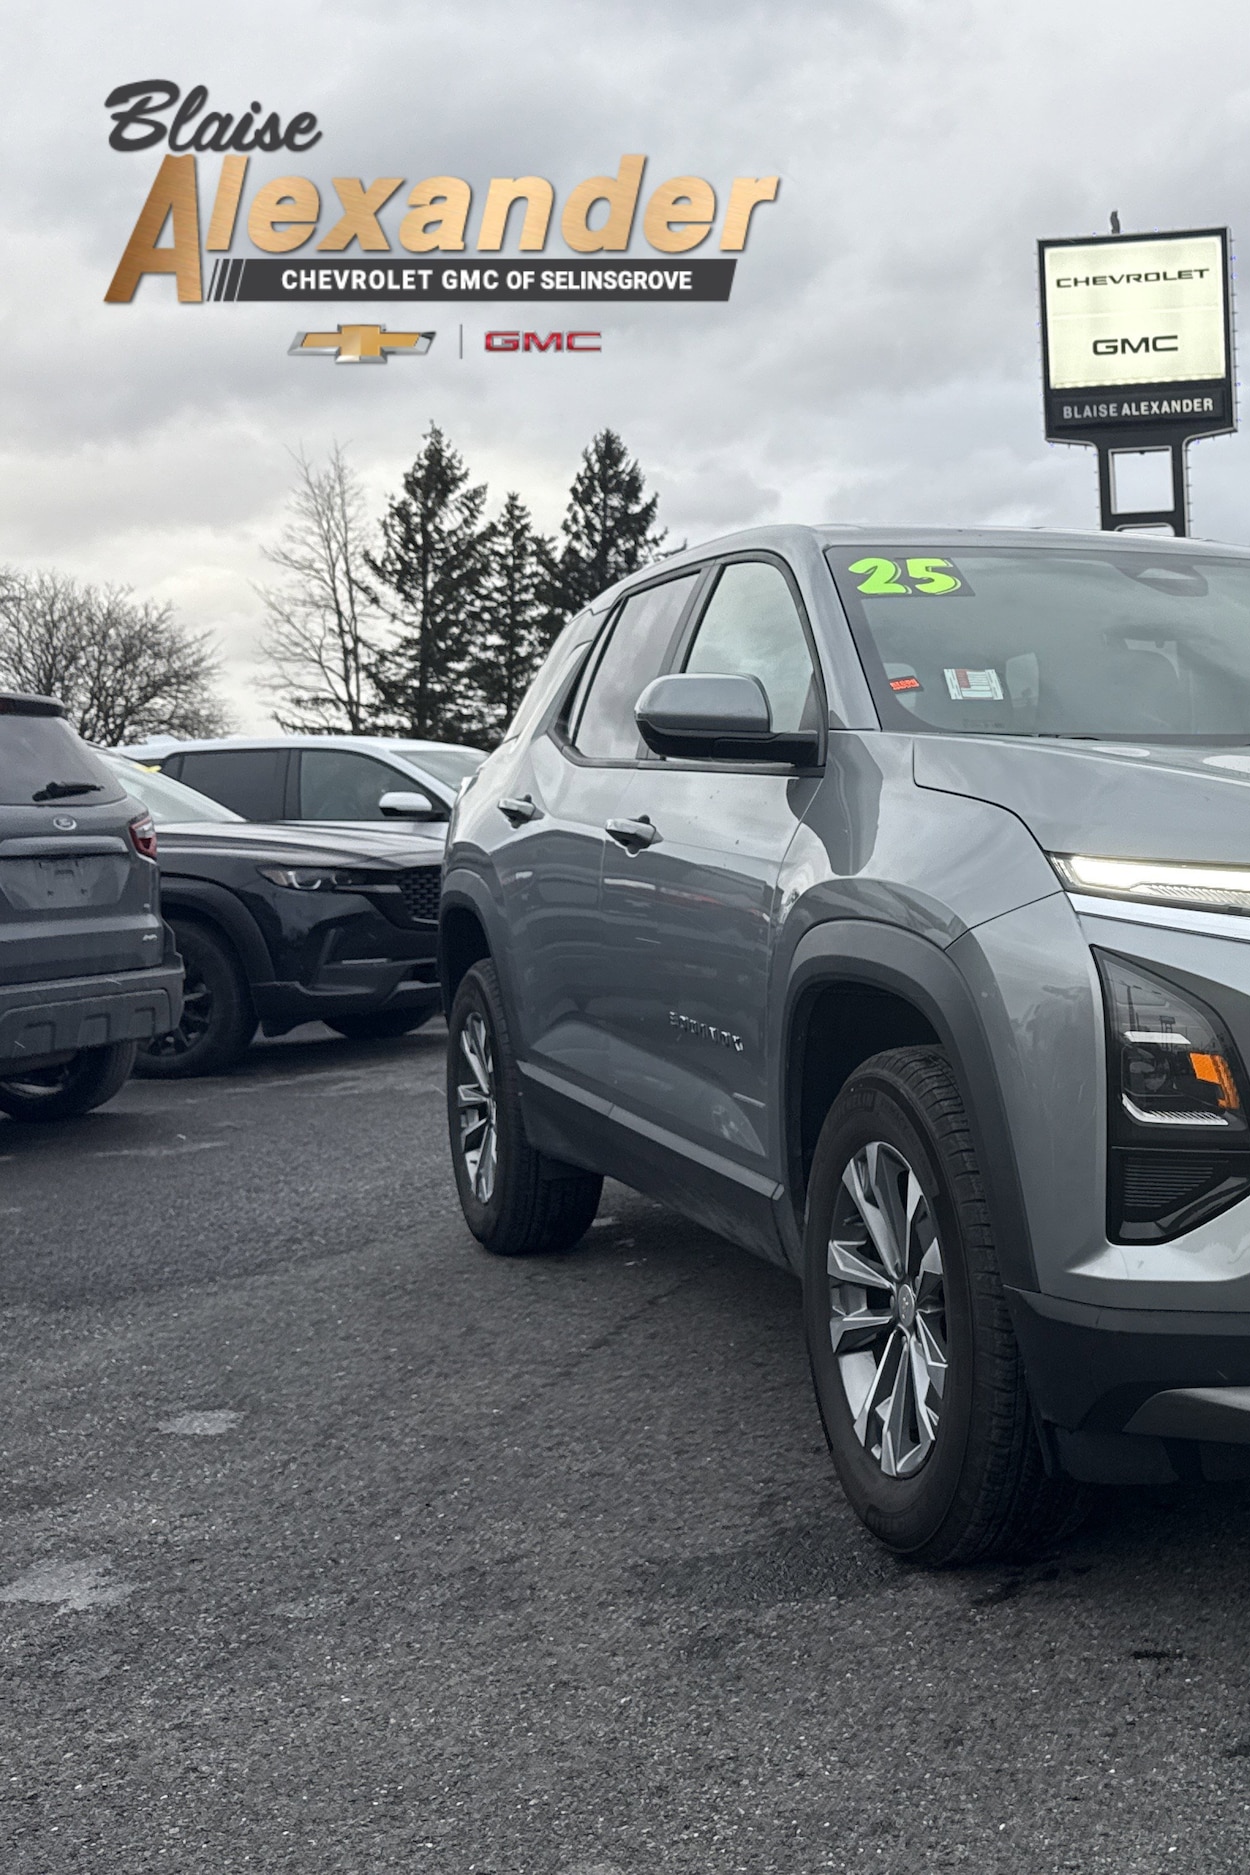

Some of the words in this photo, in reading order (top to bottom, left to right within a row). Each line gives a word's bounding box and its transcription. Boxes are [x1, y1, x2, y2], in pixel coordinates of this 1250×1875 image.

[1056, 268, 1210, 288] CHEVROLET
[1092, 335, 1179, 356] GMC
[1063, 403, 1118, 419] BLAISE
[1121, 397, 1214, 416] ALEXANDER
[848, 557, 962, 595] 25
